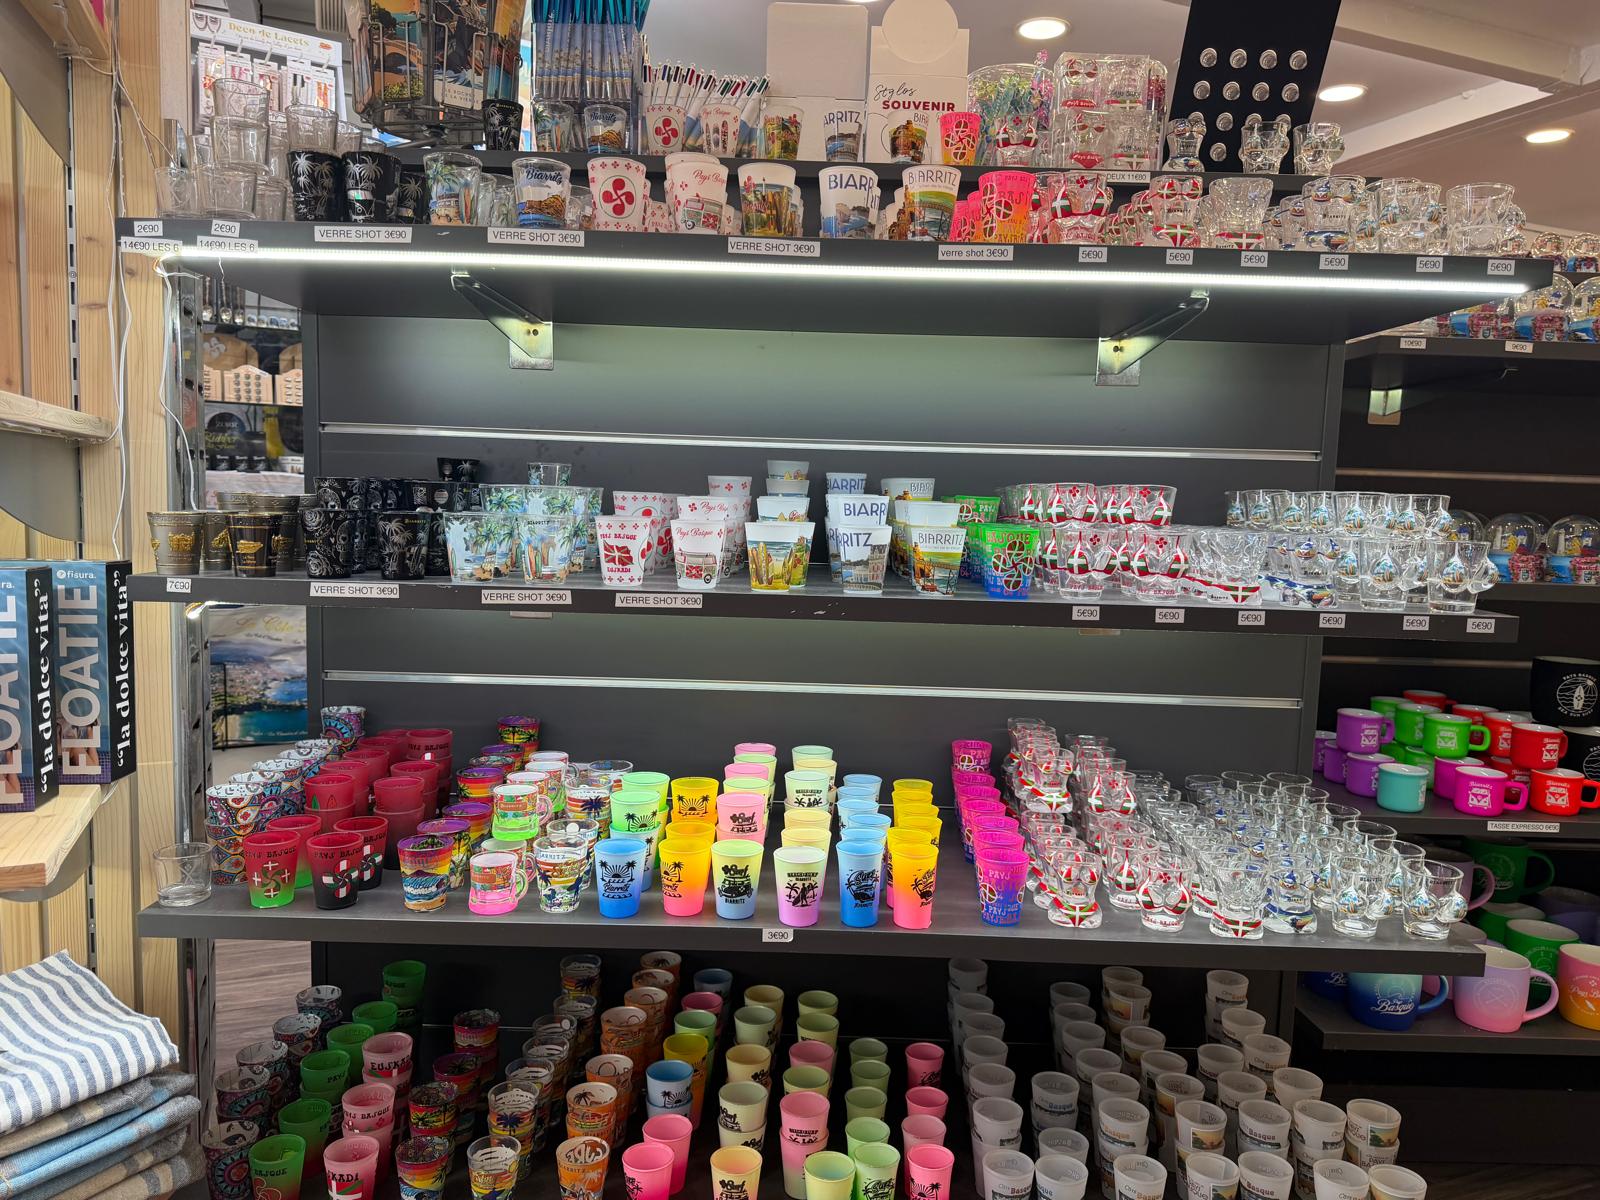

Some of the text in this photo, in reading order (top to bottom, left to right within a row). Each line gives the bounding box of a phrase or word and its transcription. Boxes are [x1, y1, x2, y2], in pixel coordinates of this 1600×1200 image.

[874, 82, 918, 100] Stylos
[882, 100, 956, 112] SOUVENIR
[526, 166, 563, 184] Biarritz
[908, 170, 958, 187] BIARRITZ
[137, 224, 159, 234] 2€90
[214, 224, 236, 234] 2€90
[319, 229, 407, 241] VERRE SHOT 3€90
[493, 230, 580, 243] VERRE SHOT 3€90
[124, 241, 179, 252] 14€90 LES 6
[228, 242, 246, 252] LES
[249, 243, 255, 252] 6
[730, 240, 815, 254] VERRE SHOT 3€90
[966, 249, 984, 258] shot
[986, 249, 1009, 258] 3€90
[1081, 250, 1103, 259] 5€90
[1168, 253, 1190, 262] 5€90
[1244, 255, 1266, 264] 5€90
[1324, 258, 1346, 267] 5€90
[1418, 260, 1440, 269] 5€90
[1490, 262, 1512, 272] 5€90
[827, 478, 864, 490] IARRIT
[676, 527, 713, 539] Pays Basque
[918, 532, 964, 545] BIARRITZ
[67, 570, 96, 580] fisura.
[168, 581, 190, 590] 7€90
[314, 586, 398, 596] VERRE SHOT 3€90
[483, 592, 567, 602] VERRE SHOT 3€90
[620, 596, 701, 606] VERRE SHOT 3€90
[1076, 609, 1098, 618] 5€90
[1158, 612, 1180, 620] 5€90
[1241, 614, 1262, 622] 5€90
[1322, 616, 1343, 625] 5€90
[1406, 619, 1427, 627] 5€90
[1471, 621, 1492, 630] 5€90
[58, 584, 102, 775] FLOATIE
[116, 640, 130, 719] dolce
[37, 656, 52, 741] dolce
[767, 932, 788, 940] 3€90
[1370, 998, 1414, 1014] Basque
[361, 1106, 390, 1119] BASQUE
[1249, 1128, 1276, 1140] Basque
[1247, 1180, 1275, 1196] Basque
